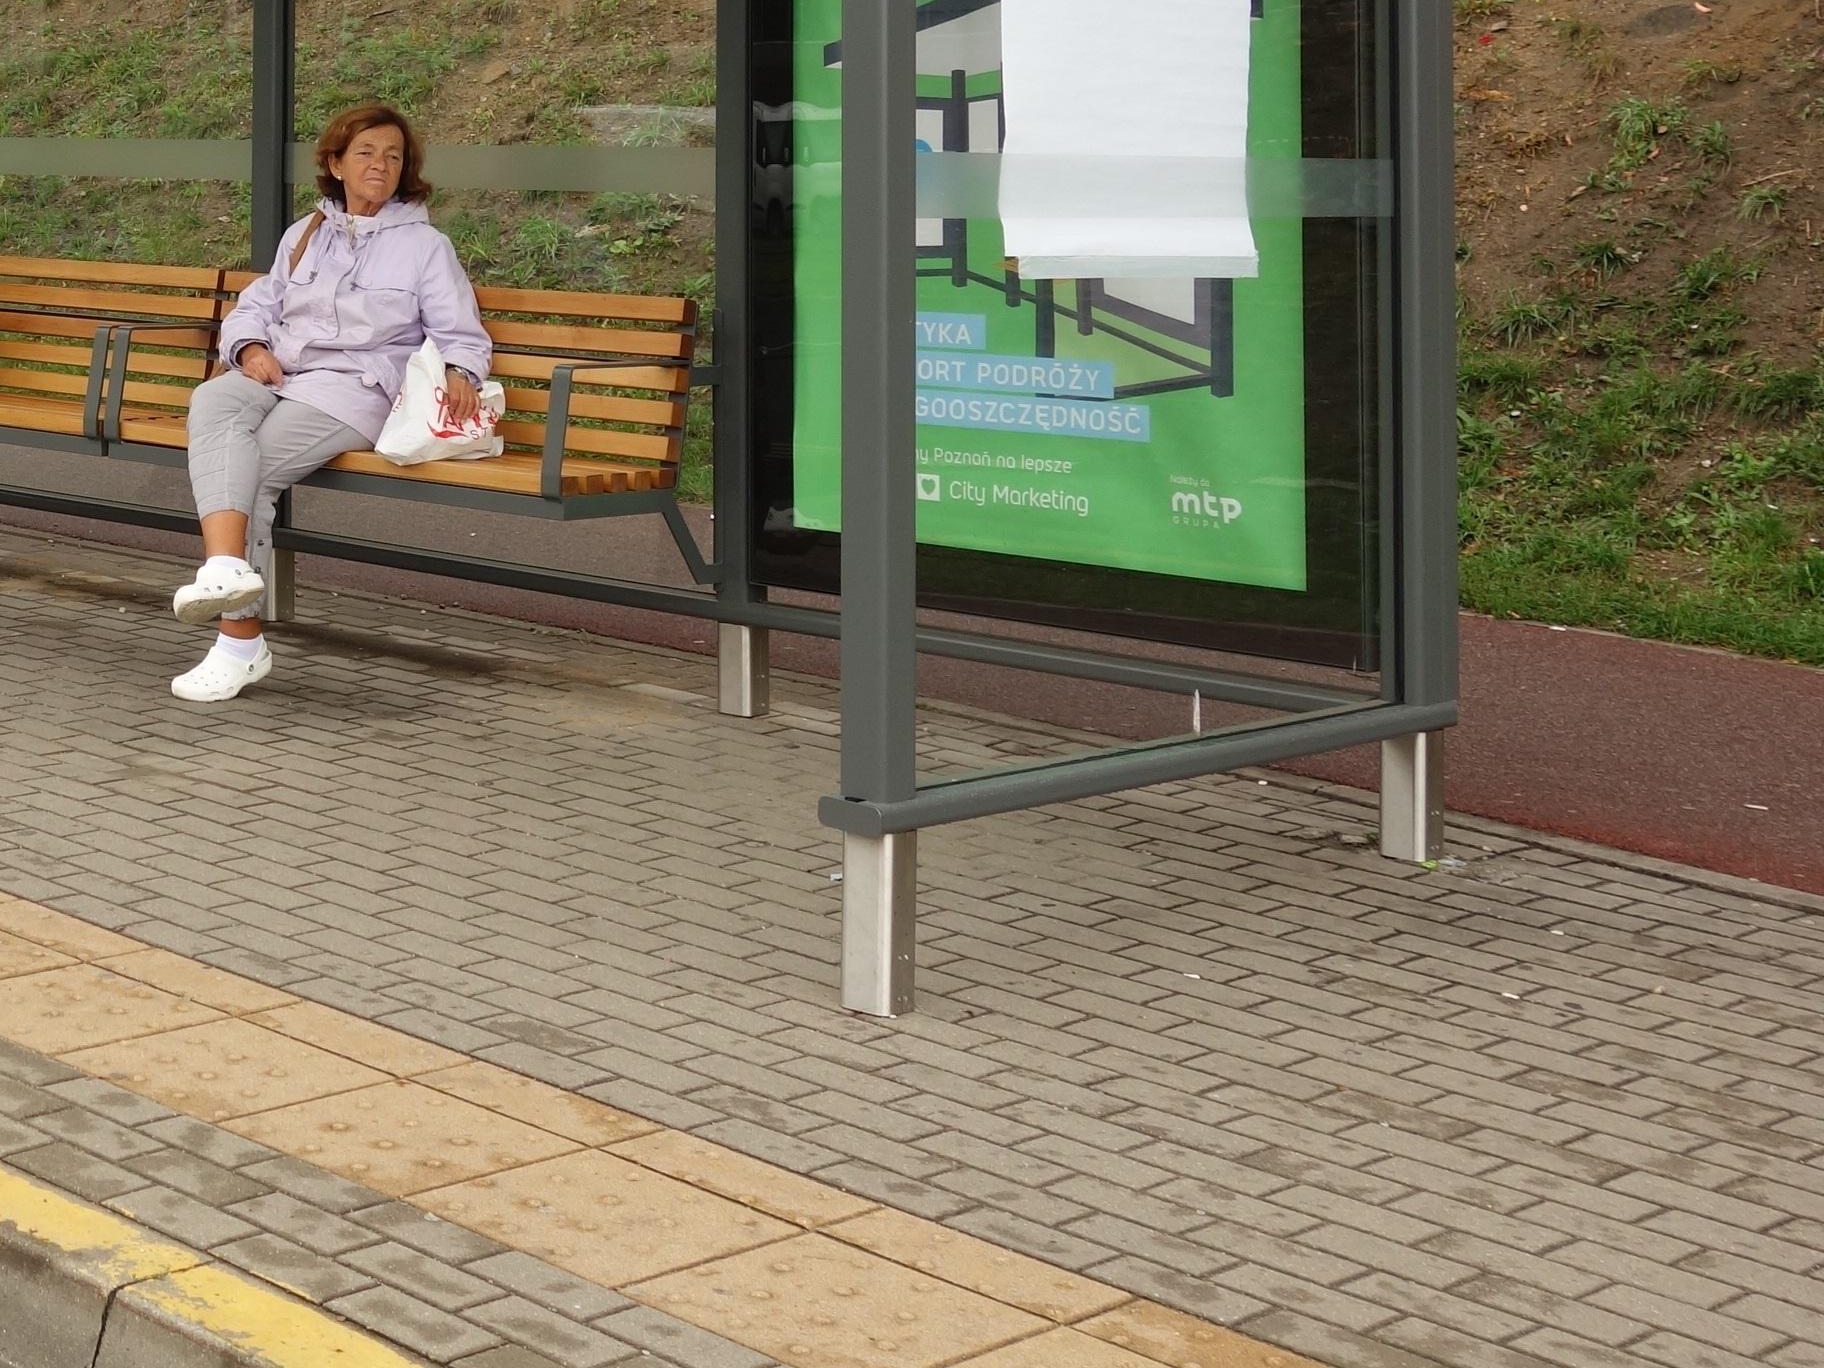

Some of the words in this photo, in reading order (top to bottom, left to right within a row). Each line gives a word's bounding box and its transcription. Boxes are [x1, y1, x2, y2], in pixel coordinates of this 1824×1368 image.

[916, 358, 966, 382] ORT
[977, 362, 1100, 392] PODRÓŻY
[916, 396, 1141, 435] GOOSZCZĘDNOŚĆ
[934, 448, 991, 467] Poznań
[995, 455, 1016, 469] na
[1021, 454, 1072, 474] lepsze
[949, 480, 986, 507] City
[992, 484, 1089, 517] Marketing
[1171, 490, 1242, 524] mtp
[1172, 516, 1220, 529] GRUPA
